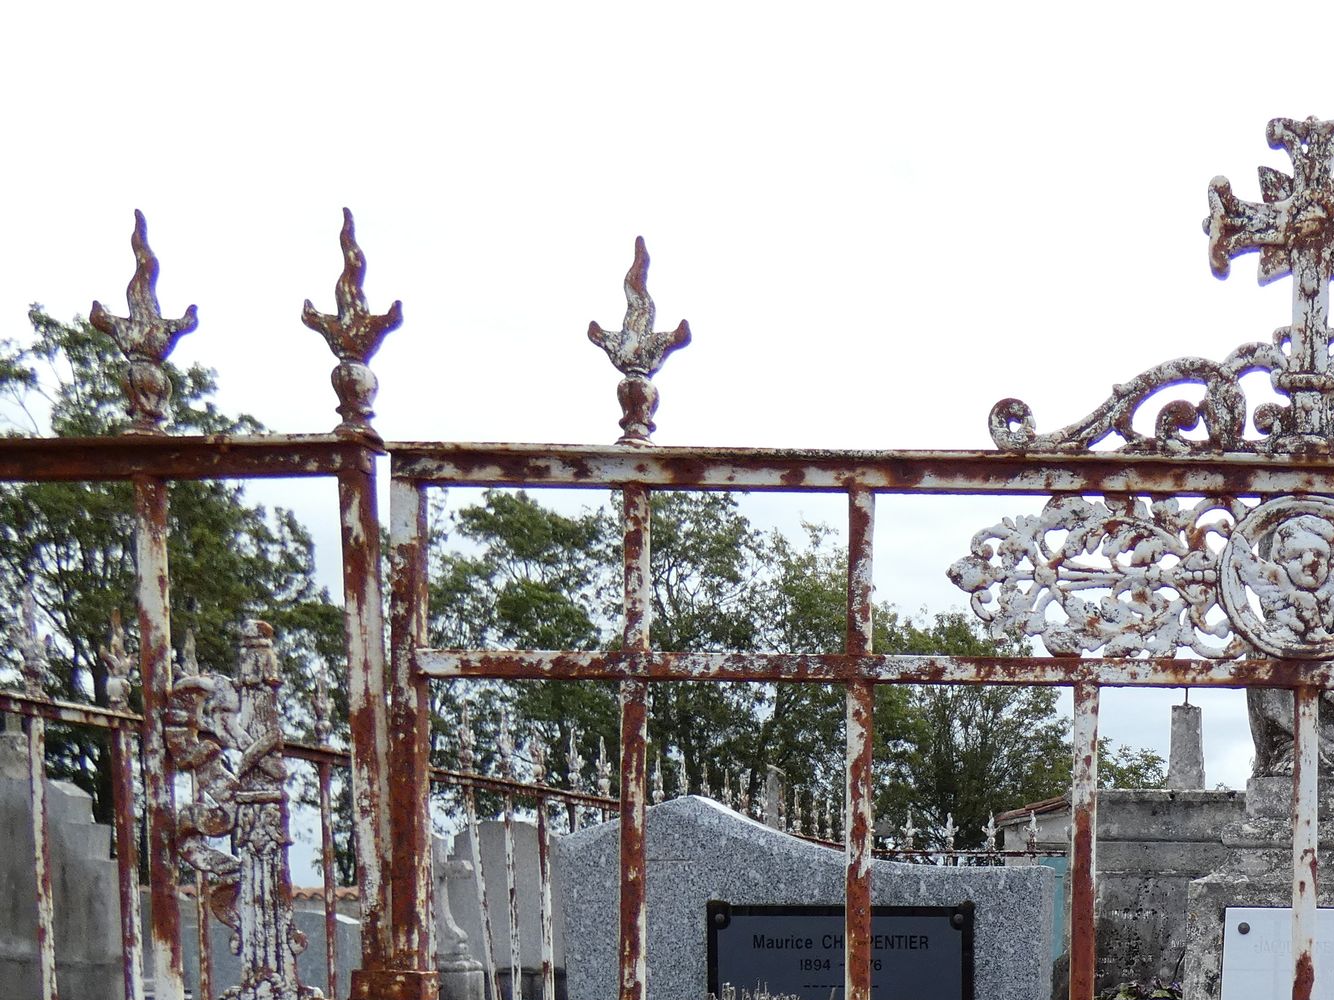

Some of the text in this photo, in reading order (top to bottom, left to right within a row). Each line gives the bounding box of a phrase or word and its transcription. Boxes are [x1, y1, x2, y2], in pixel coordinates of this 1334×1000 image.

[752, 934, 929, 950] Maurice CHENTIER
[799, 958, 831, 972] 1894
